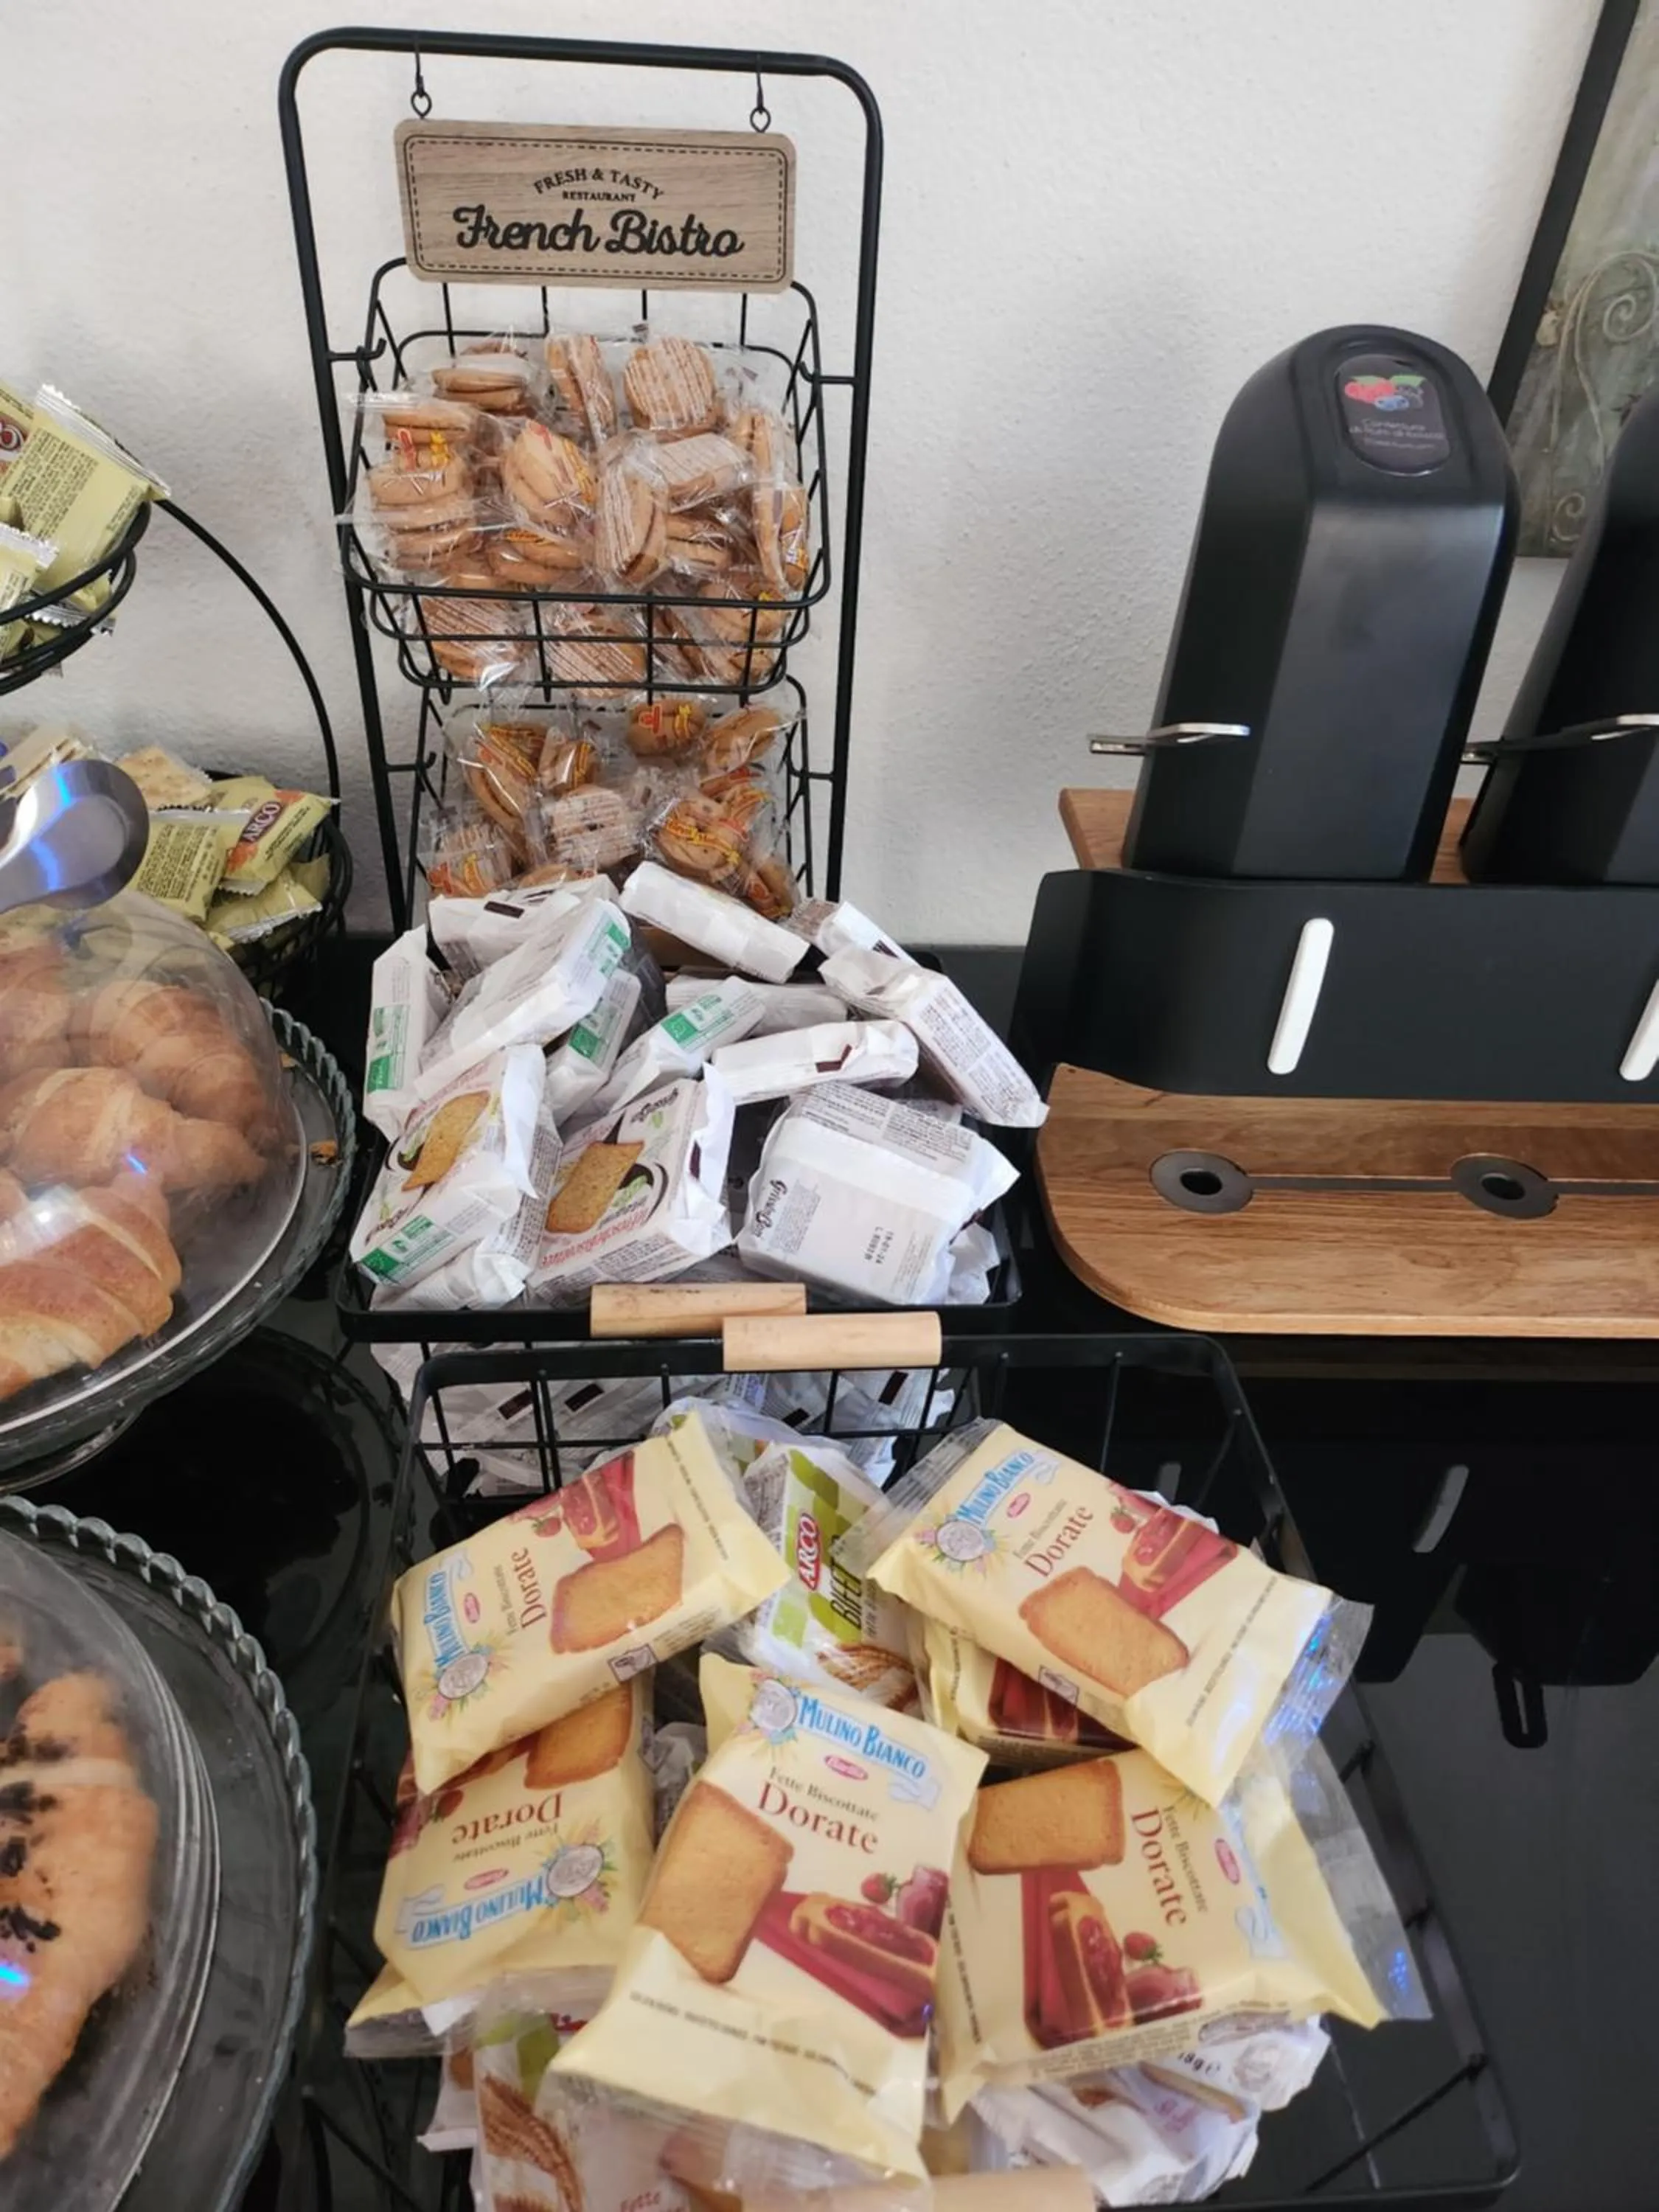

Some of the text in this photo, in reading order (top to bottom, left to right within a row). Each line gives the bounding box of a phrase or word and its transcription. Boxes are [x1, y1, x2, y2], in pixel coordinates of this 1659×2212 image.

[533, 167, 664, 200] FRESH & TASTY
[562, 190, 636, 202] RESTAURANT
[453, 204, 745, 257] French Bistro
[244, 804, 279, 842] ARCO
[799, 1515, 818, 1584] ARCO
[1023, 1506, 1095, 1577] Dorate
[511, 1547, 548, 1630] Dorate
[451, 1792, 563, 1845] Dorate
[758, 1781, 878, 1854] Dorate
[769, 1767, 804, 1793] Fette
[807, 1784, 880, 1822] Biscottate
[1130, 1806, 1186, 1927] Dorate
